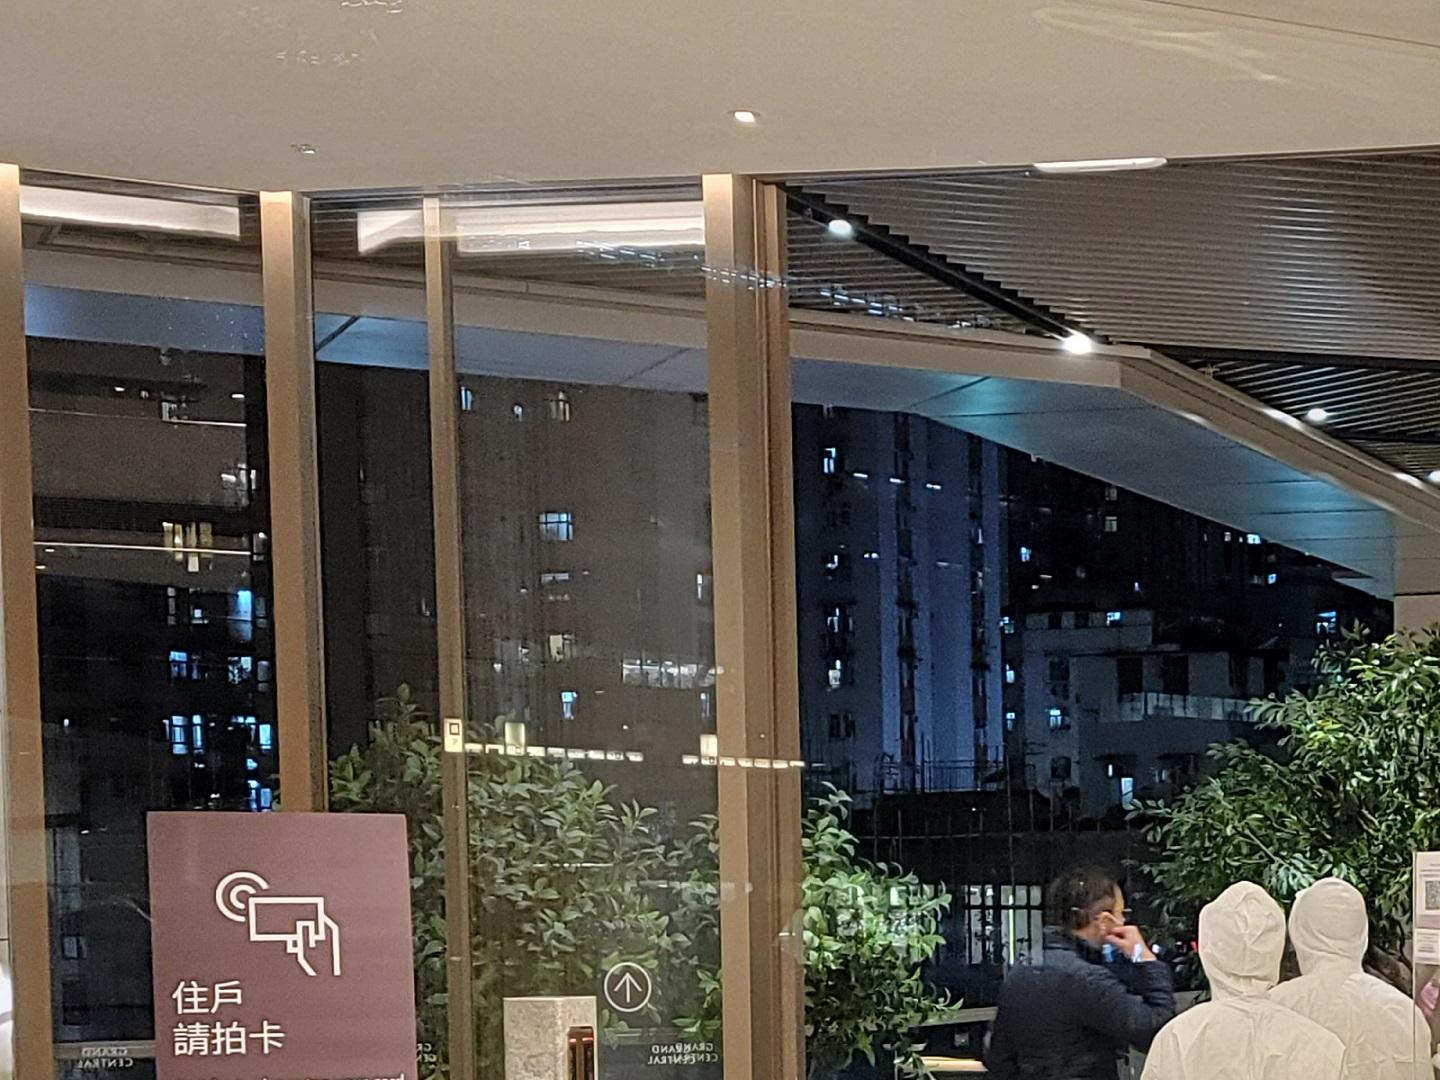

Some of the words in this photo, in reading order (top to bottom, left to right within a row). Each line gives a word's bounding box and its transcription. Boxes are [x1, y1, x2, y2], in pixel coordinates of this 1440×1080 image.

[172, 980, 243, 1015] 住戶
[172, 1020, 285, 1056] 請拍卡
